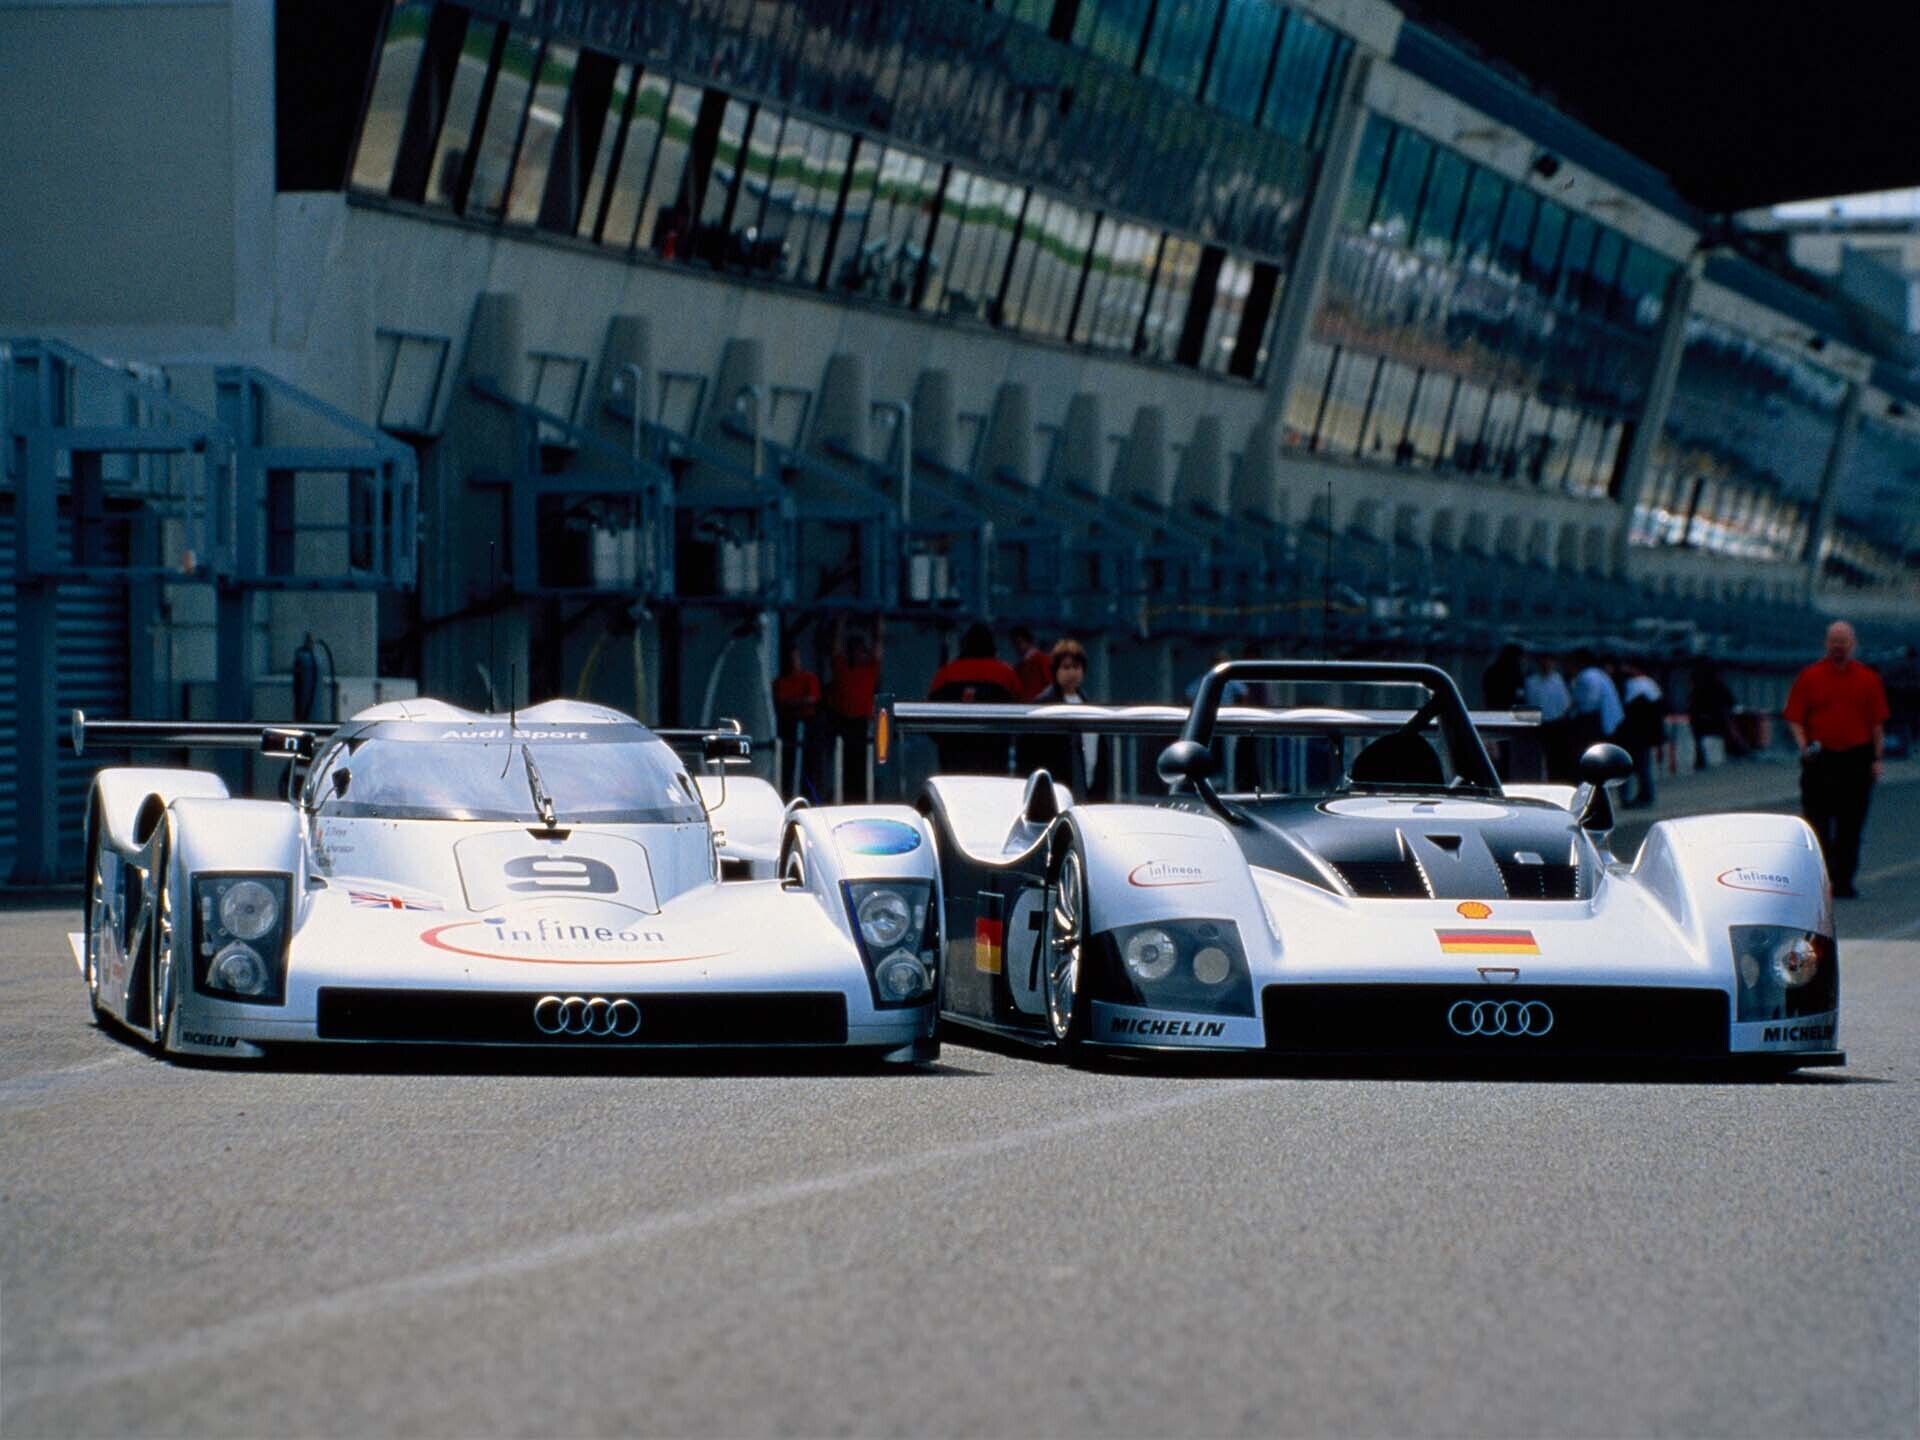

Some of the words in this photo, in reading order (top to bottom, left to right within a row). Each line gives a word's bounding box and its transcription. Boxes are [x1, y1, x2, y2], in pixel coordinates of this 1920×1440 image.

[440, 730, 504, 740] Audi
[512, 730, 589, 740] Sport
[503, 855, 619, 894] 9
[484, 917, 665, 943] infineon
[1028, 910, 1049, 992] 7
[1110, 1017, 1226, 1037] MICHELIN
